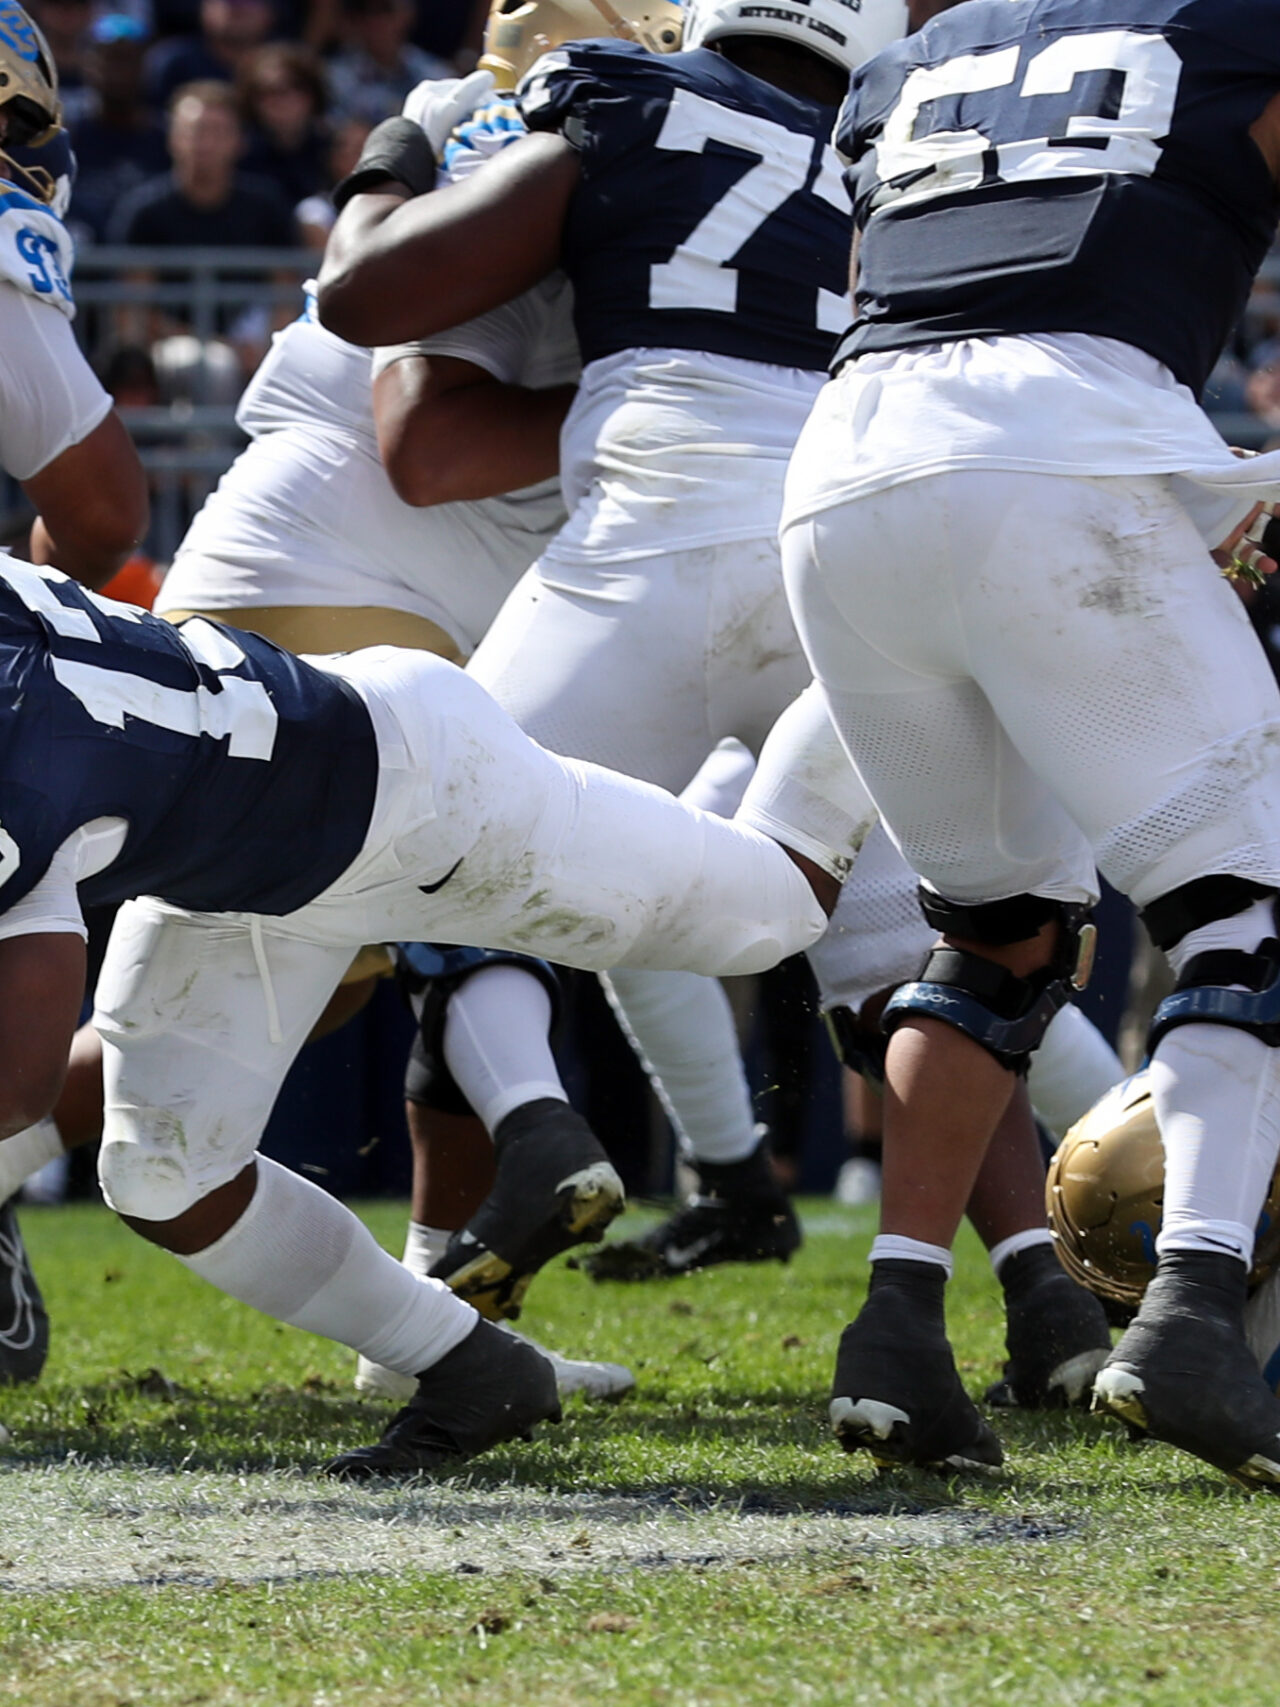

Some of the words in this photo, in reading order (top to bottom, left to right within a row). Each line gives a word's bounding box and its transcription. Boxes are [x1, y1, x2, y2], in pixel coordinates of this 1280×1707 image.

[739, 7, 804, 25] NITTANY
[807, 18, 847, 46] LIONS
[871, 30, 1183, 217] 53
